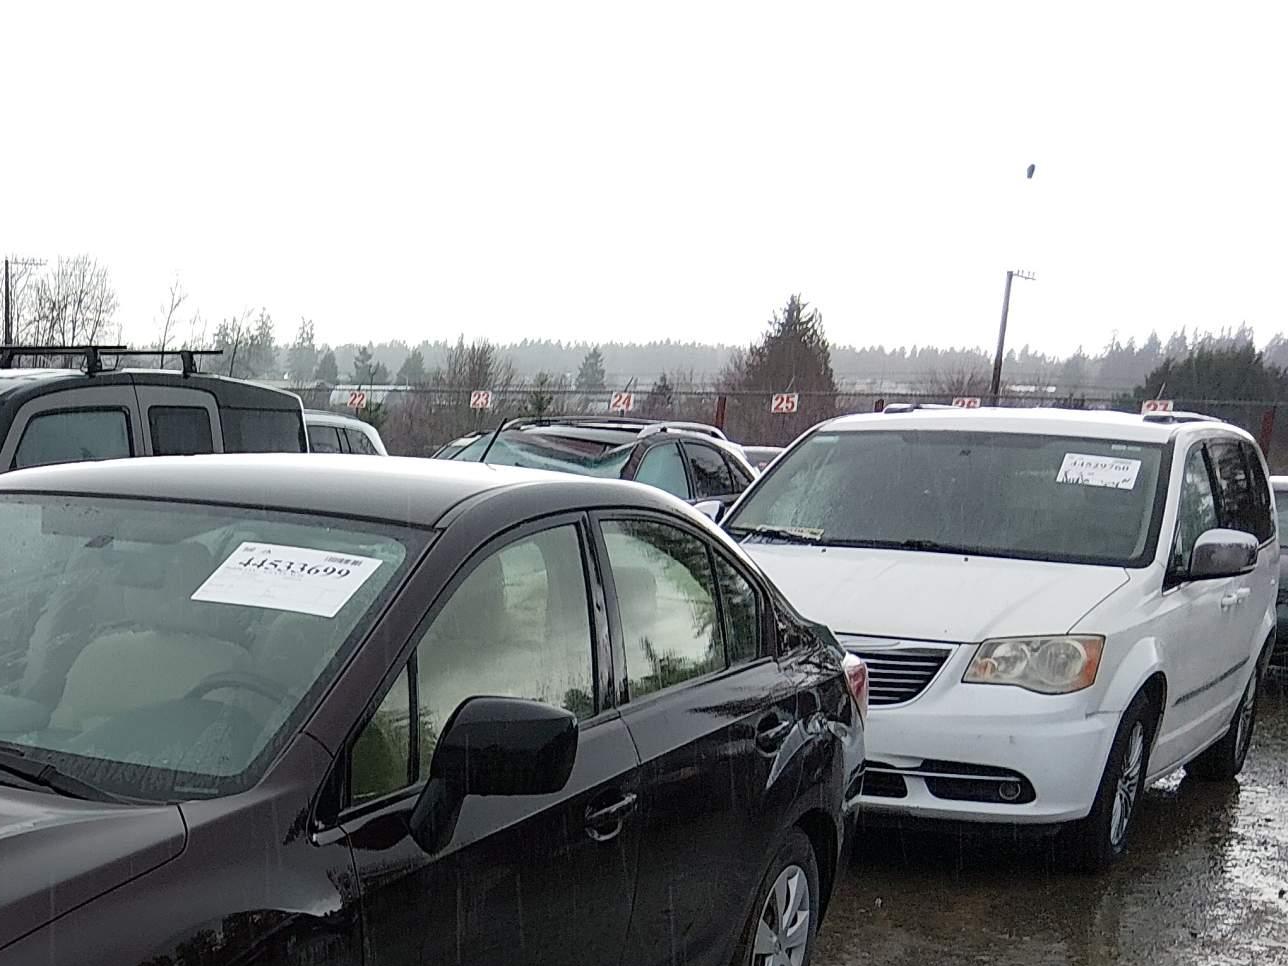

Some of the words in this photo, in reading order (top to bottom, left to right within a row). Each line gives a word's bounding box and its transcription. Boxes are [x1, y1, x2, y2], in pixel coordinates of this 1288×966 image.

[349, 392, 365, 407] 22
[472, 392, 490, 406] 23
[612, 394, 632, 409] 24
[774, 395, 796, 411] 25
[238, 556, 351, 579] 44533699
